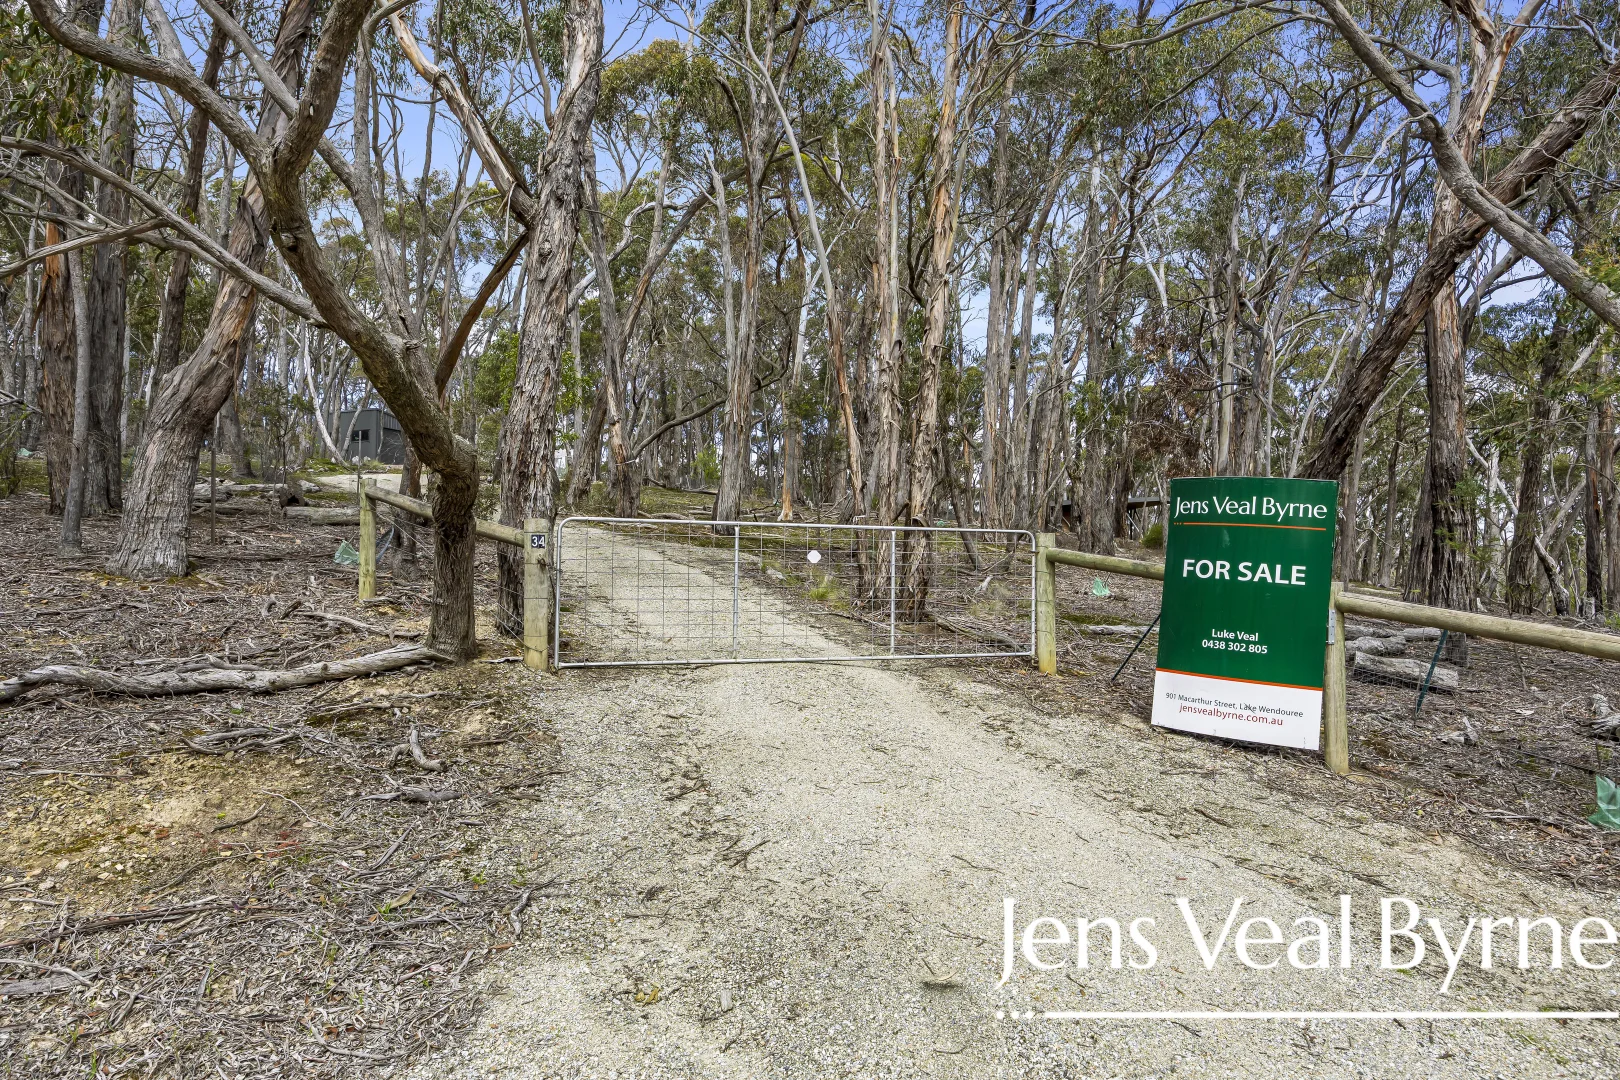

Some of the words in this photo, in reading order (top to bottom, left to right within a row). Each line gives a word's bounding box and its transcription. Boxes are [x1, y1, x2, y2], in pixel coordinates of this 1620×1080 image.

[1174, 497, 1209, 519] Jens
[1212, 496, 1257, 515] Veal
[1262, 497, 1327, 522] Byrne
[531, 535, 546, 547] 34
[1182, 559, 1231, 580] FOR
[1237, 561, 1307, 586] SALE
[1202, 639, 1226, 650] 0438
[1227, 641, 1246, 652] 302
[1248, 643, 1268, 654] 805
[1211, 628, 1236, 640] Luke
[1236, 630, 1259, 642] Veal
[1165, 692, 1177, 700] 901
[1177, 693, 1213, 706] Macarthur
[1214, 699, 1238, 710] Street,
[1239, 702, 1257, 713] Lake
[1258, 704, 1304, 718] Wendouree
[1179, 703, 1284, 726] jensvealbyrne.com.au
